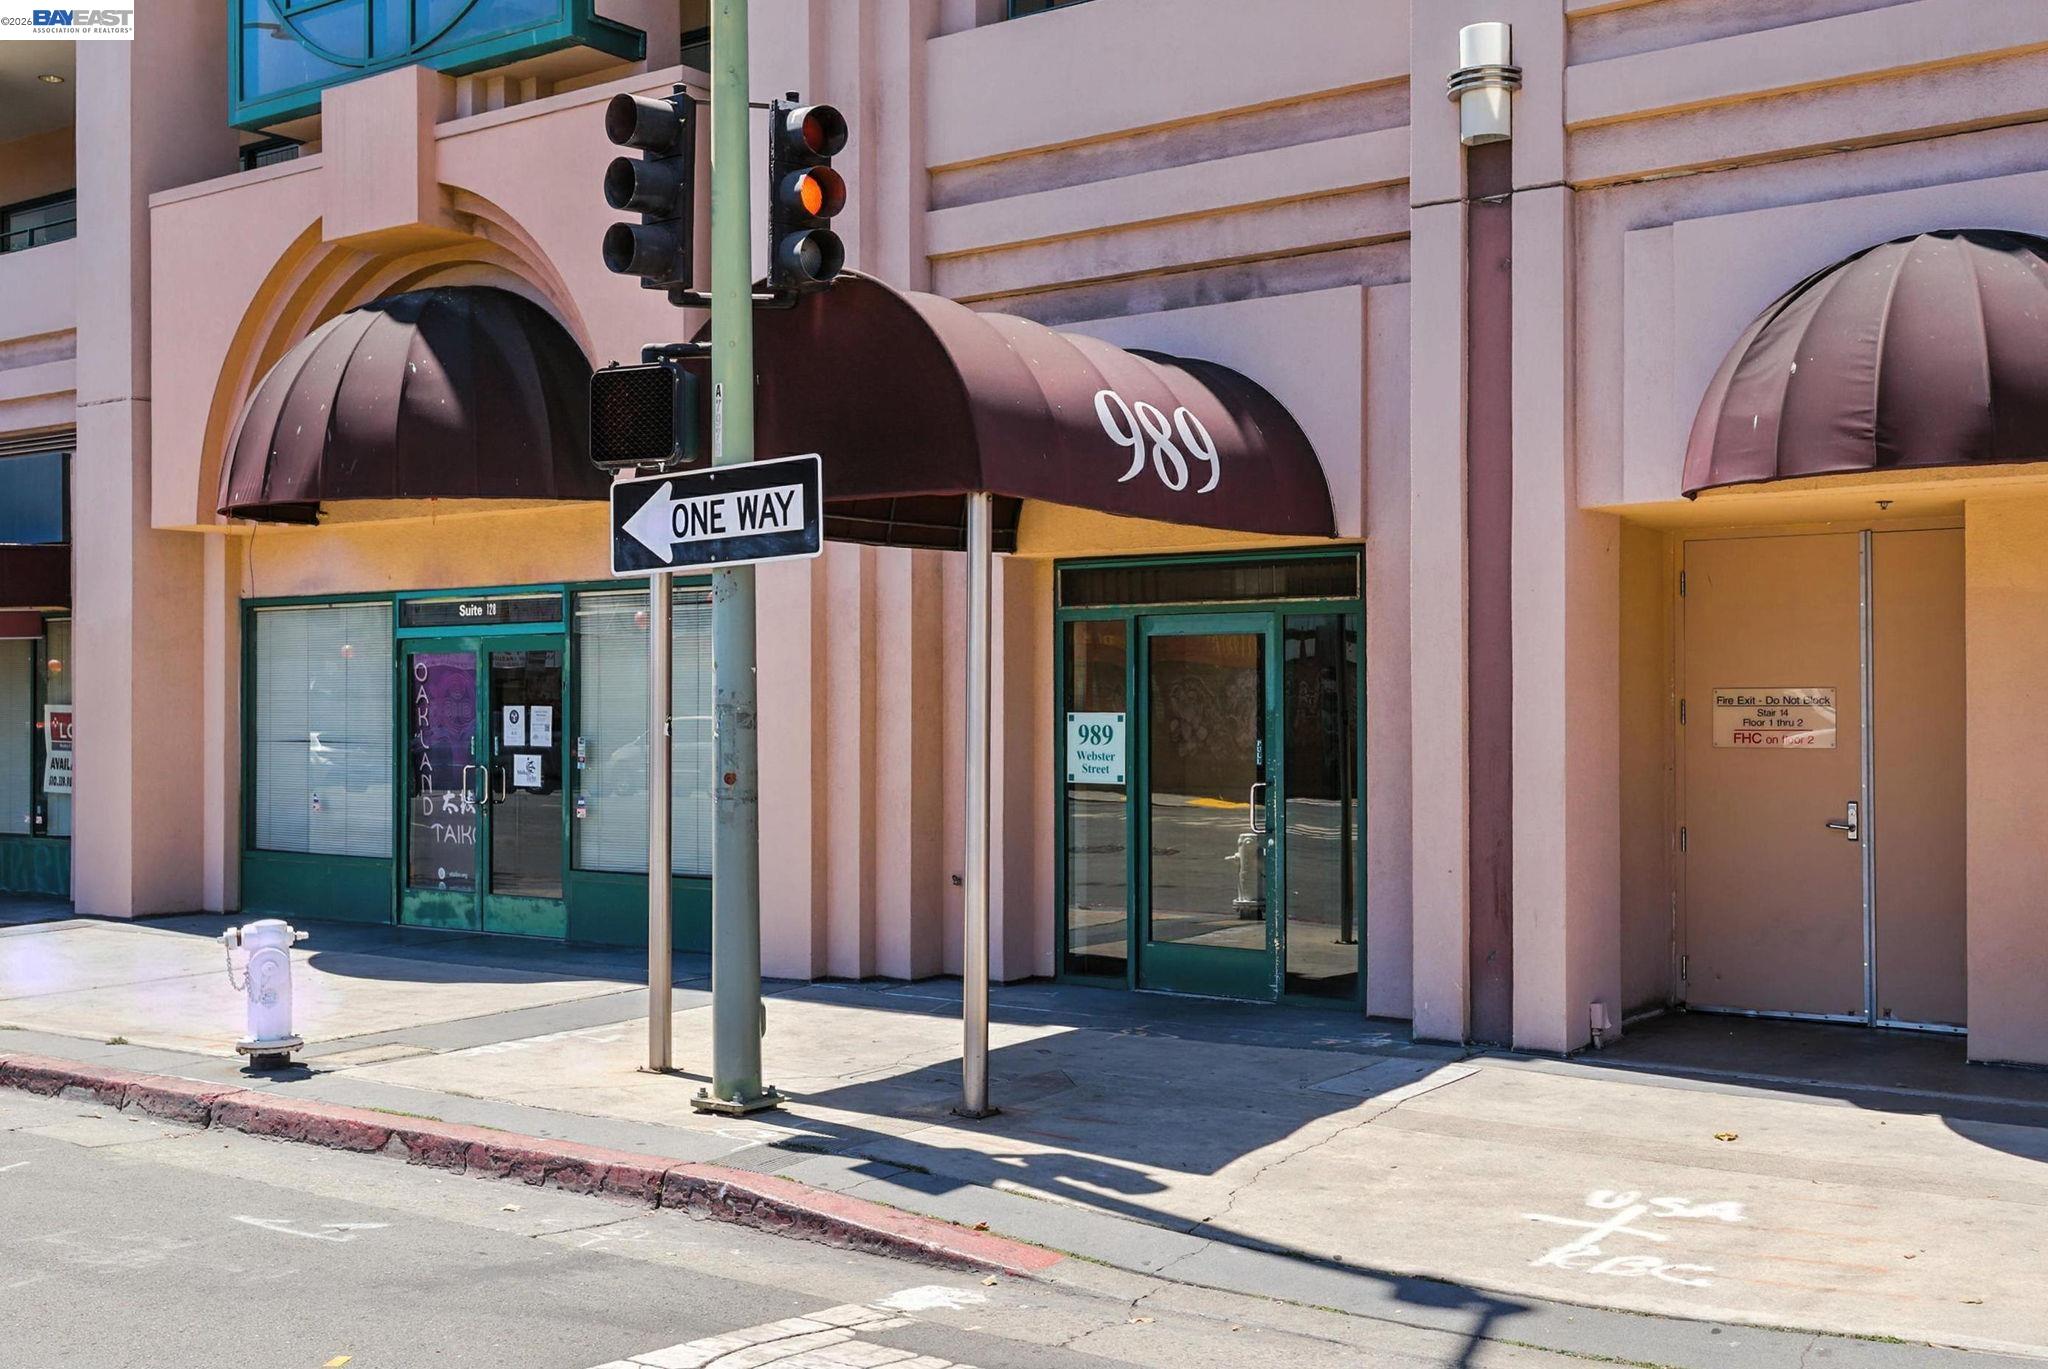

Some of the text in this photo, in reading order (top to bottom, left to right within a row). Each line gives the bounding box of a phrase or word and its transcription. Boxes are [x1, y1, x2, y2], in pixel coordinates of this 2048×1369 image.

[1093, 389, 1221, 494] 989
[672, 490, 795, 538] ONE WAY
[459, 604, 483, 617] Suite
[1716, 696, 1734, 705] Fire
[1737, 696, 1755, 705] Exit
[1766, 696, 1780, 705] Do
[1783, 696, 1801, 705] Not
[1757, 708, 1789, 717] Stair 14
[1743, 718, 1765, 727] Floor
[1777, 718, 1795, 727] thru
[1797, 719, 1804, 727] 2
[414, 662, 434, 816] OAKLAND
[1078, 724, 1114, 746] 989
[1733, 733, 1762, 744] FHC
[1807, 735, 1815, 745] 2
[1076, 750, 1116, 762] Webster
[50, 757, 72, 771] AVAIL
[1082, 763, 1110, 774] Street
